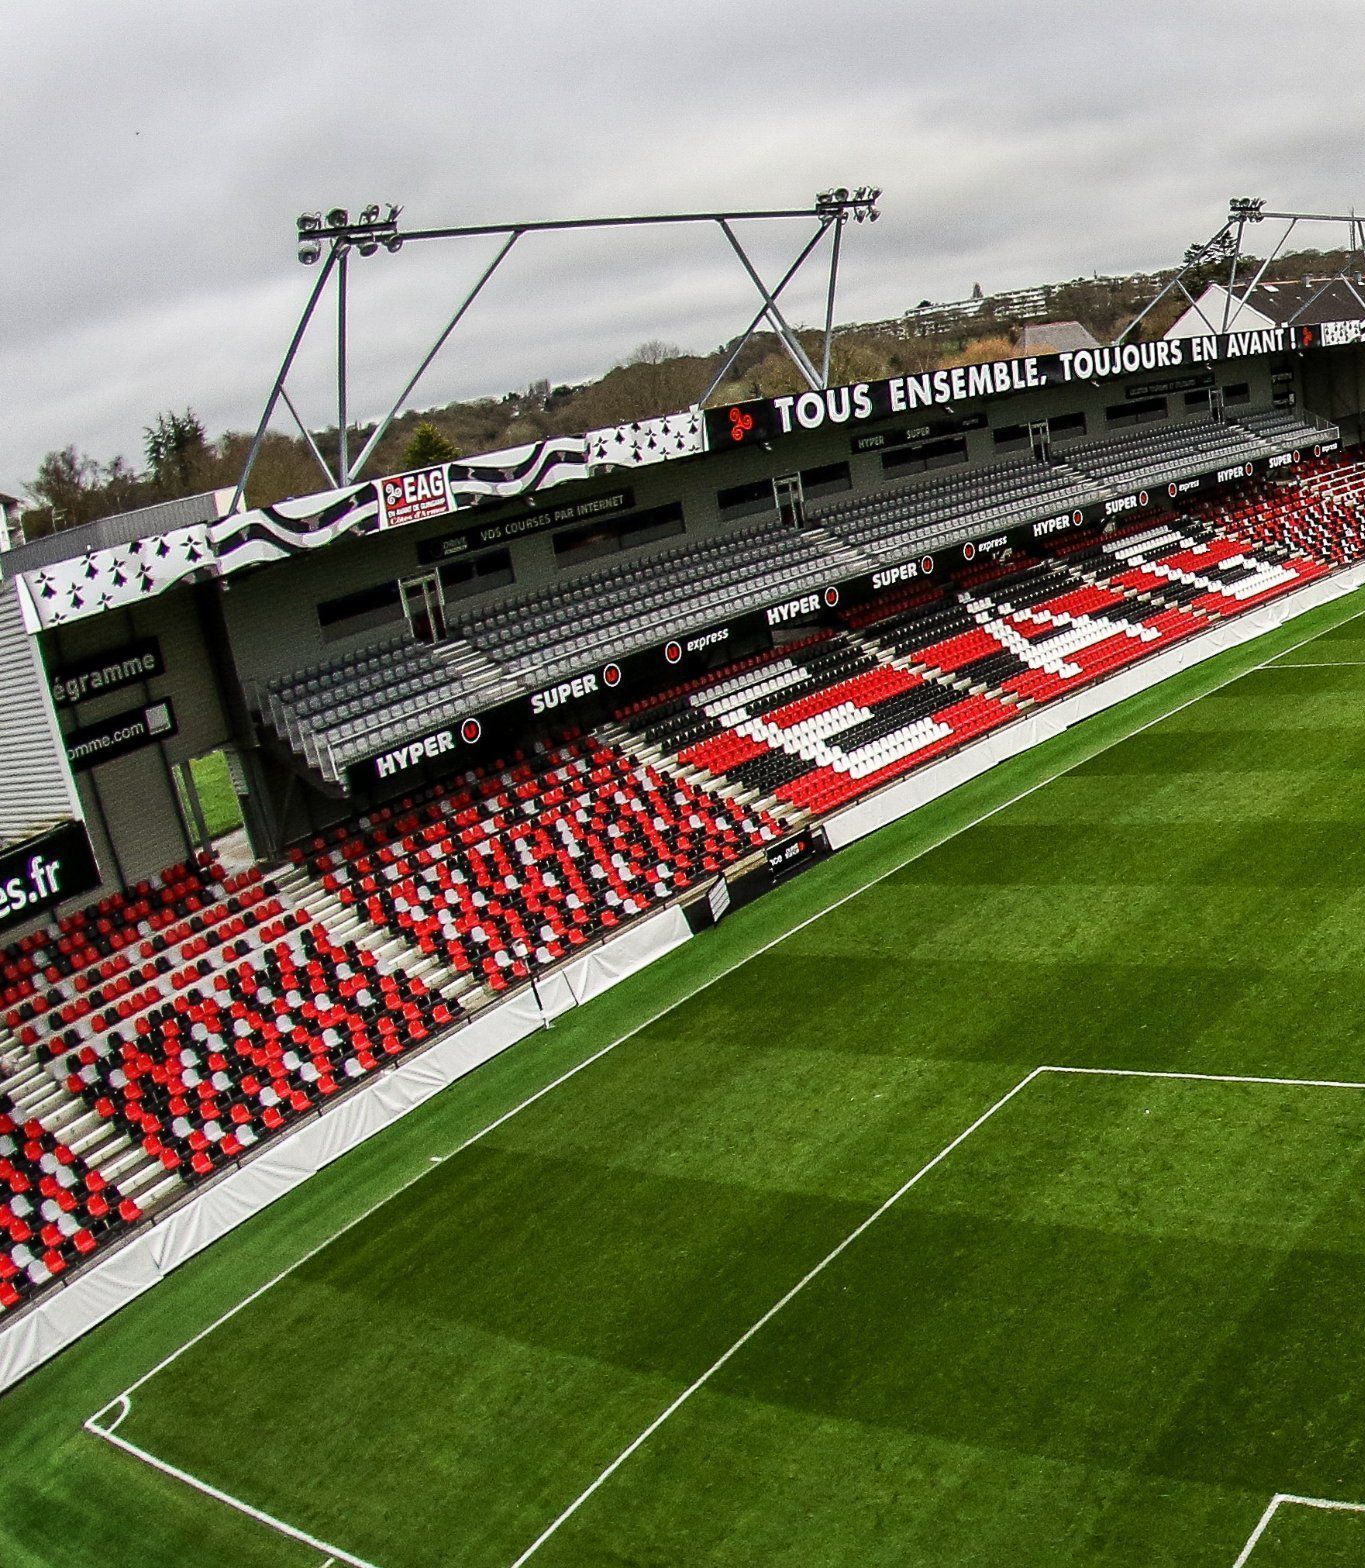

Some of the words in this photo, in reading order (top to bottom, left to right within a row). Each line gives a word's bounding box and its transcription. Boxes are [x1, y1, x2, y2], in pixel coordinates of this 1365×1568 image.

[774, 383, 873, 433] TOUS
[888, 358, 1048, 412] ENSEMBLE,
[1060, 338, 1182, 381] TOUJOURS
[1192, 335, 1217, 362] EN
[1227, 328, 1284, 358] AVANT
[1290, 327, 1297, 350] !
[1217, 466, 1244, 482] HYPER
[1269, 453, 1292, 468] SUPER
[403, 470, 444, 504] EAG
[1178, 480, 1200, 492] express
[480, 529, 502, 541] VOS
[505, 513, 550, 535] COURSES
[554, 508, 574, 521] PAR
[577, 494, 624, 515] INTERNET
[1105, 494, 1137, 516] SUPER
[1033, 512, 1070, 538] HYPER
[978, 536, 1008, 552] express
[872, 562, 918, 590] SUPER
[766, 593, 821, 626] HYPER
[686, 627, 730, 653] express
[53, 653, 155, 701] égramme
[530, 673, 599, 714] SUPER
[375, 730, 455, 779] HYPER
